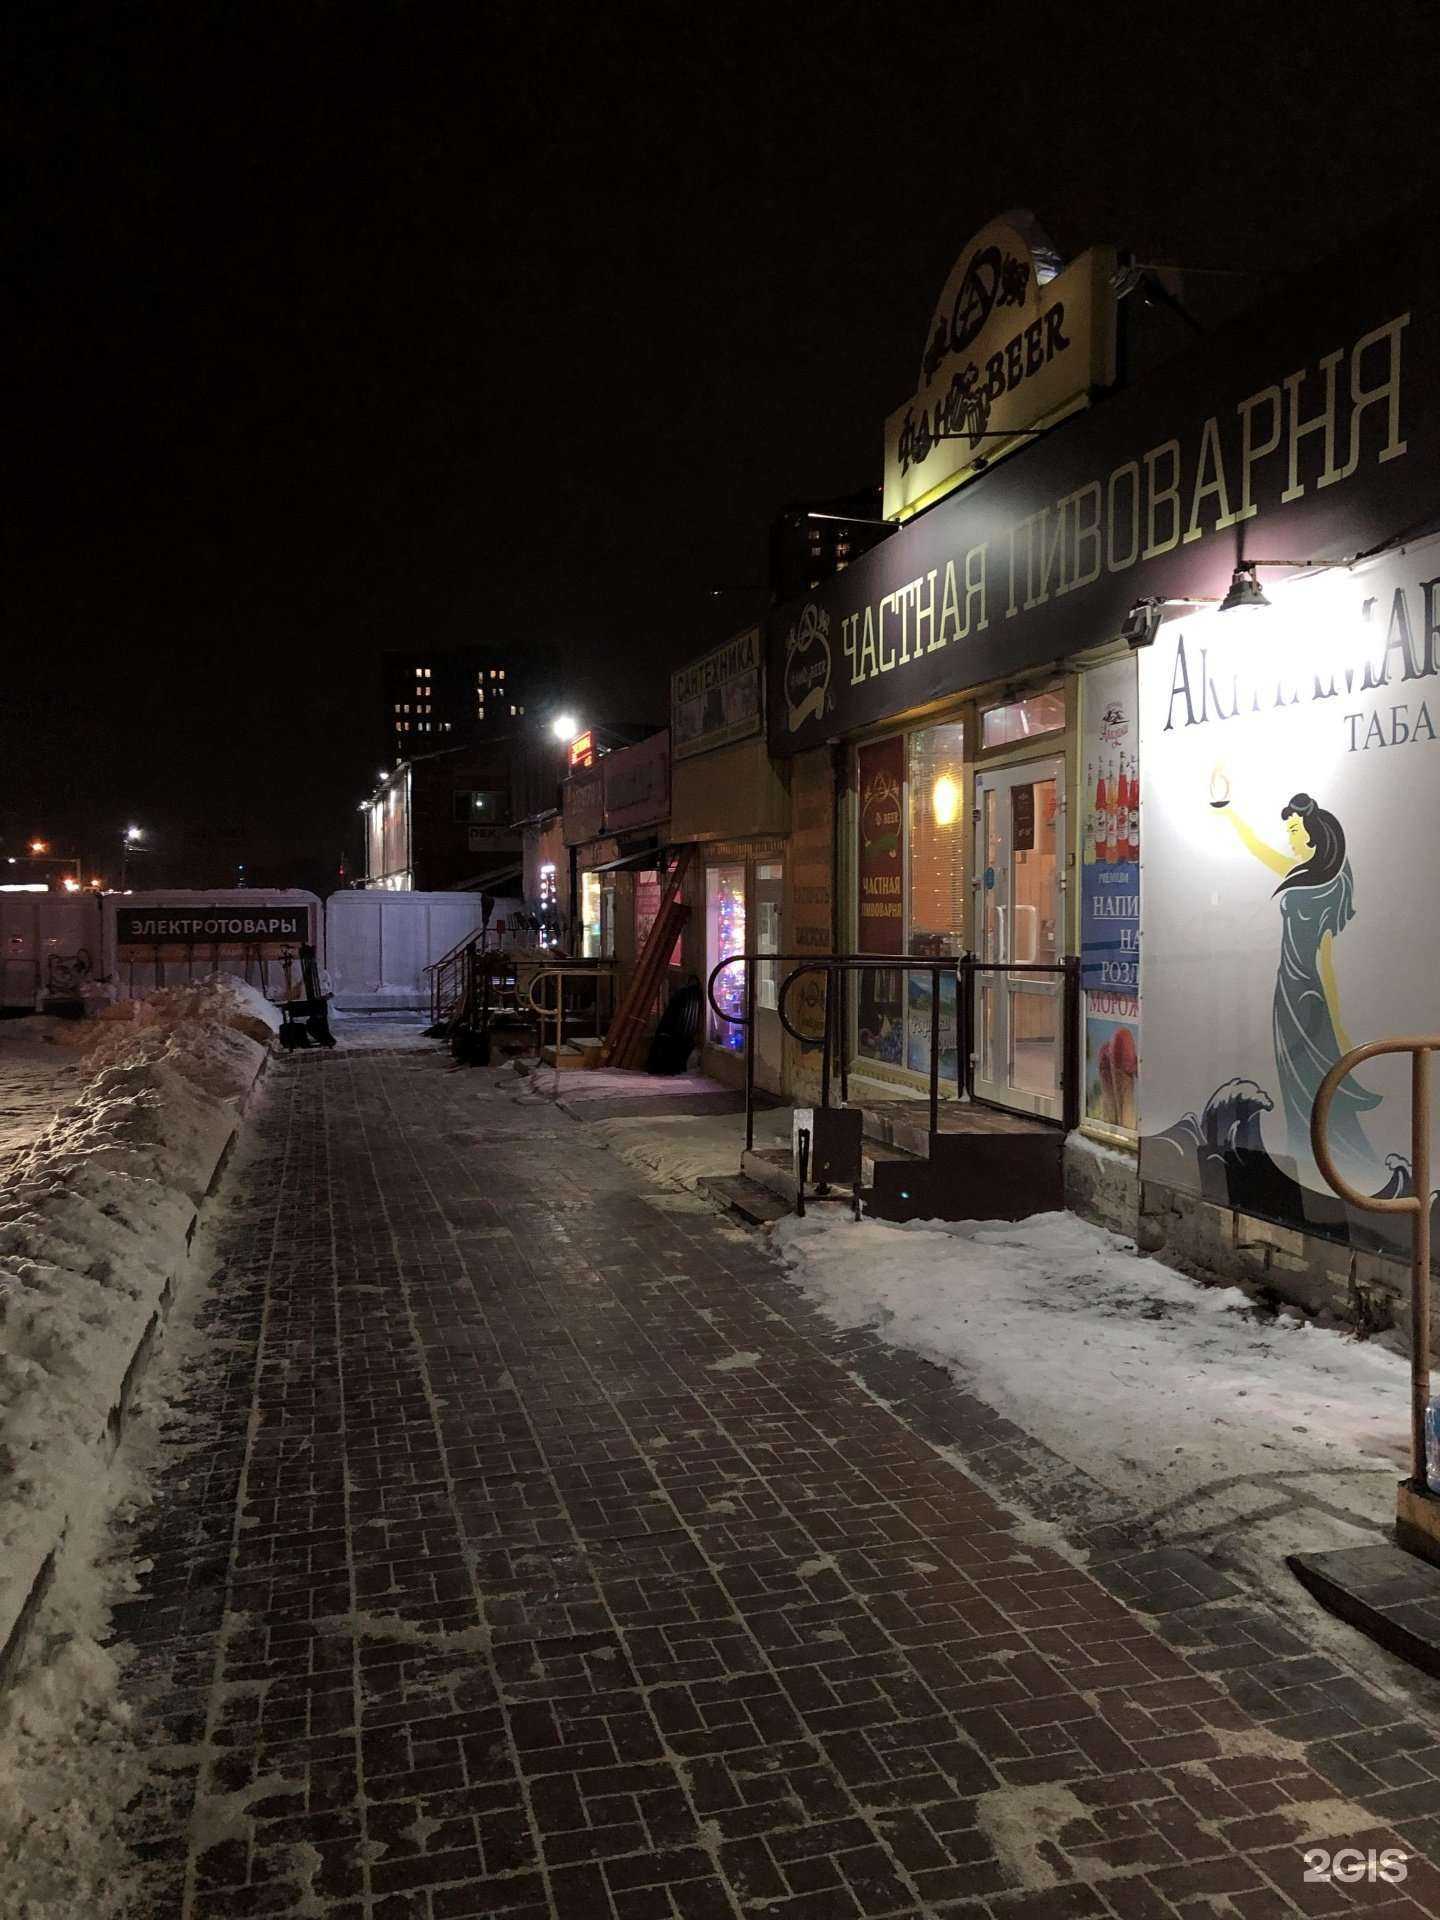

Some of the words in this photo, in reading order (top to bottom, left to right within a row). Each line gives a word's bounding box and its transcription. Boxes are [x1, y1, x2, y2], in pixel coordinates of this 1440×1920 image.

[985, 301, 1071, 402] BEER
[841, 543, 988, 687] ЧАСТНАЯ
[1005, 311, 1411, 618] ПИВОВАРНЯ
[863, 875, 901, 895] ЧАСТНАЯ
[131, 918, 297, 936] ЭЛЕКТРОТОВАРЫ
